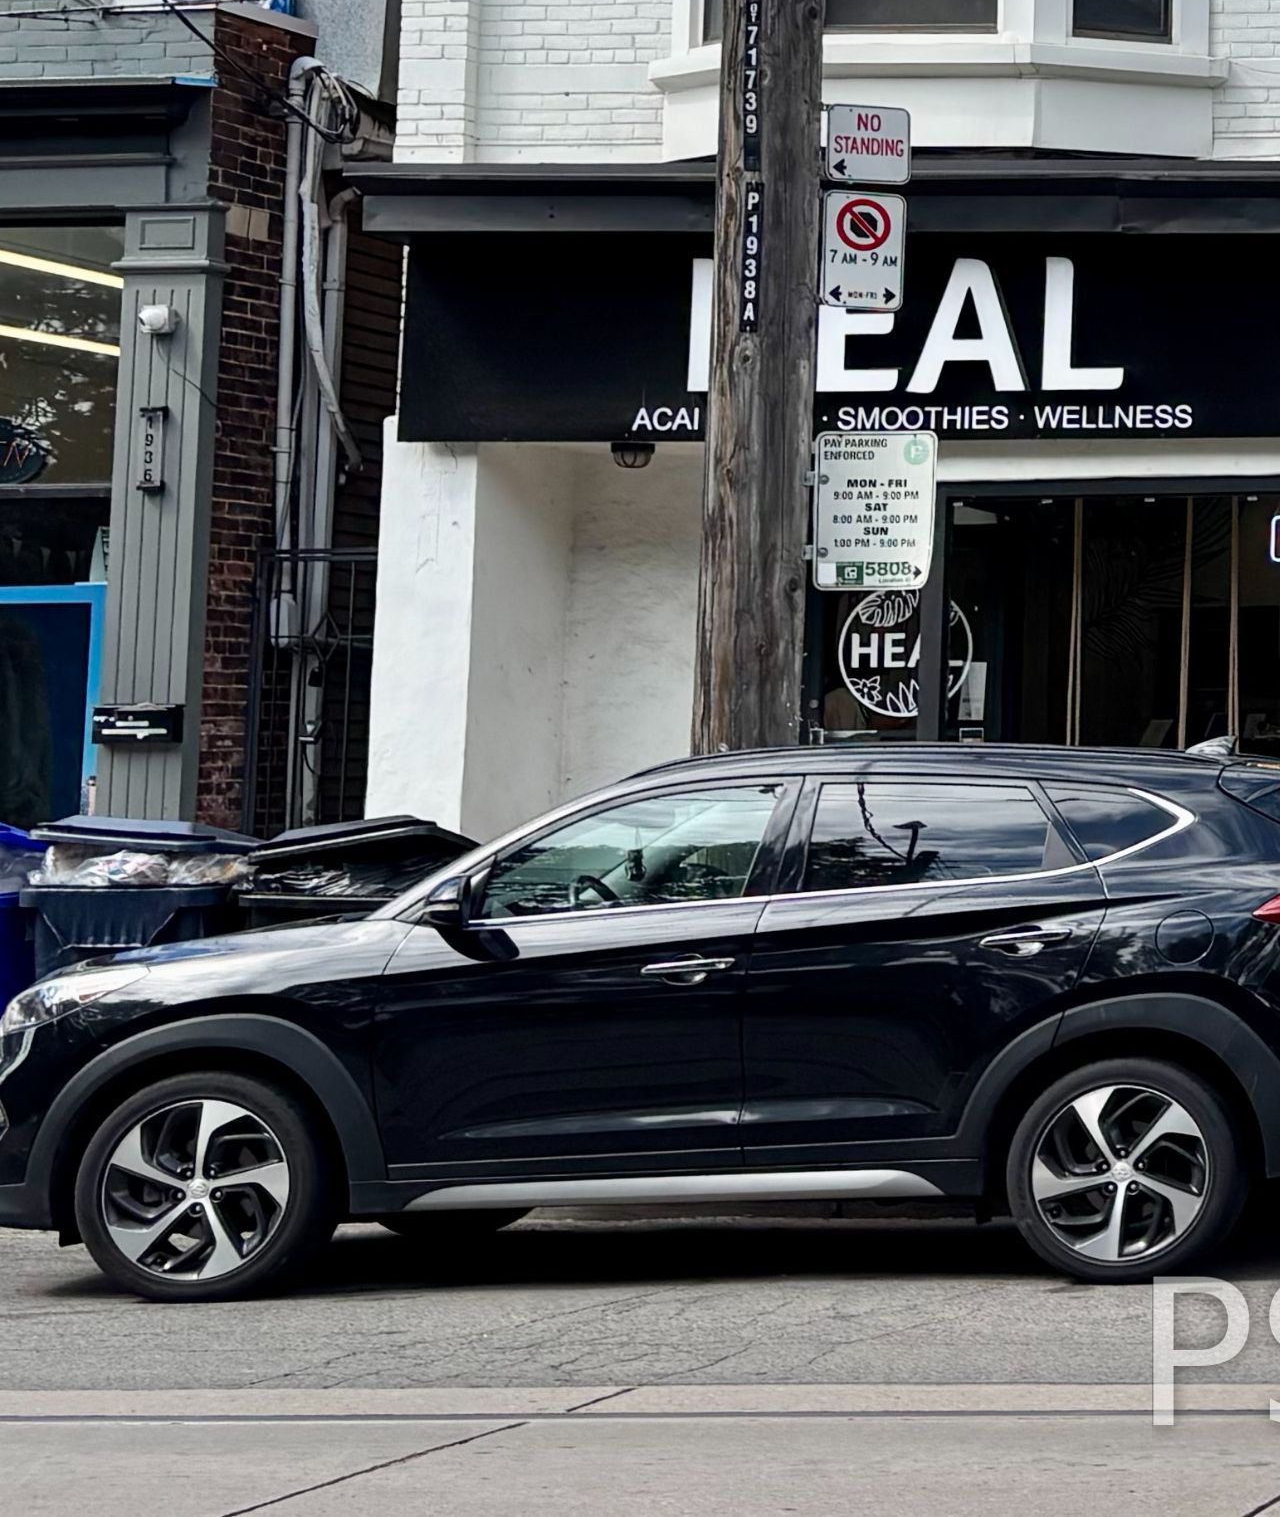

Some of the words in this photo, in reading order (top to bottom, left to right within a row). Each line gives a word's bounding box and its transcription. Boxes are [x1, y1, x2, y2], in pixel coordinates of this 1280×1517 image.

[857, 113, 882, 132] NO
[834, 135, 904, 158] STANDING
[829, 249, 838, 263] 7
[841, 252, 858, 265] AM
[870, 252, 879, 266] 9
[882, 255, 898, 267] AM
[632, 408, 699, 432] ACAI
[837, 406, 1009, 431] SMOOTHIES
[1034, 405, 1193, 429] WELLNESS
[824, 438, 842, 448] PAY
[844, 438, 888, 448] PARKING
[144, 416, 153, 482] 1936
[824, 450, 875, 460] ENFORCED
[847, 479, 877, 488] MON
[888, 479, 907, 488] FRI
[833, 491, 853, 500] 9:00
[857, 491, 873, 500] AM
[883, 491, 901, 500] 9:00
[904, 491, 919, 499] PM
[865, 503, 888, 511] SAT
[832, 515, 852, 524] 8:00
[856, 515, 872, 523] AM
[881, 515, 900, 523] 9:00
[903, 515, 918, 523] PM
[863, 527, 888, 535] SUN
[855, 539, 870, 547] PM
[879, 539, 898, 547] 9:00
[901, 539, 916, 547] PM
[864, 562, 912, 576] 5808
